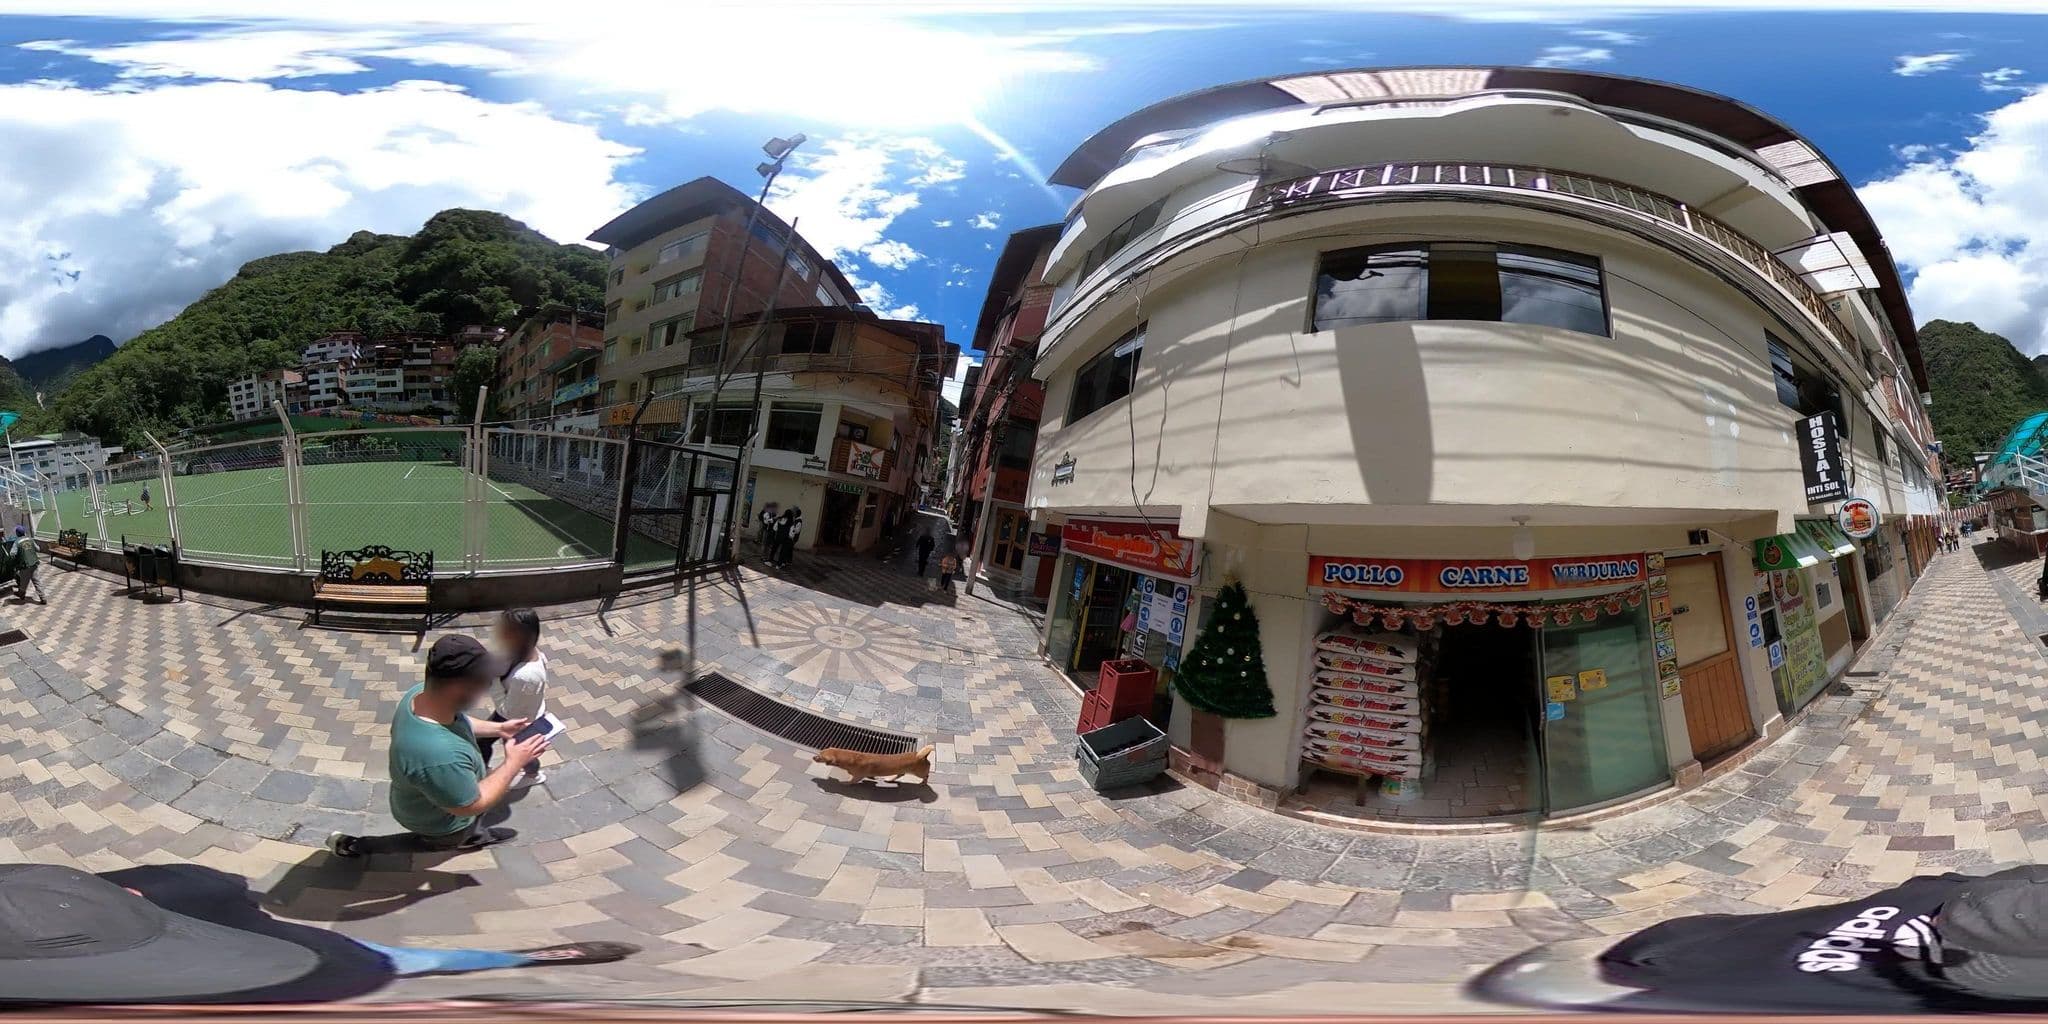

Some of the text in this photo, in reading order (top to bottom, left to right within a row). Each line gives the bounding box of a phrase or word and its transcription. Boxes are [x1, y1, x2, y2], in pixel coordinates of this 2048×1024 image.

[1808, 415, 1830, 482] HOSTAL
[1824, 481, 1840, 492] SOL
[1325, 560, 1639, 586] POLLO CARNE VERDURAS
[1798, 906, 1900, 972] adidas
